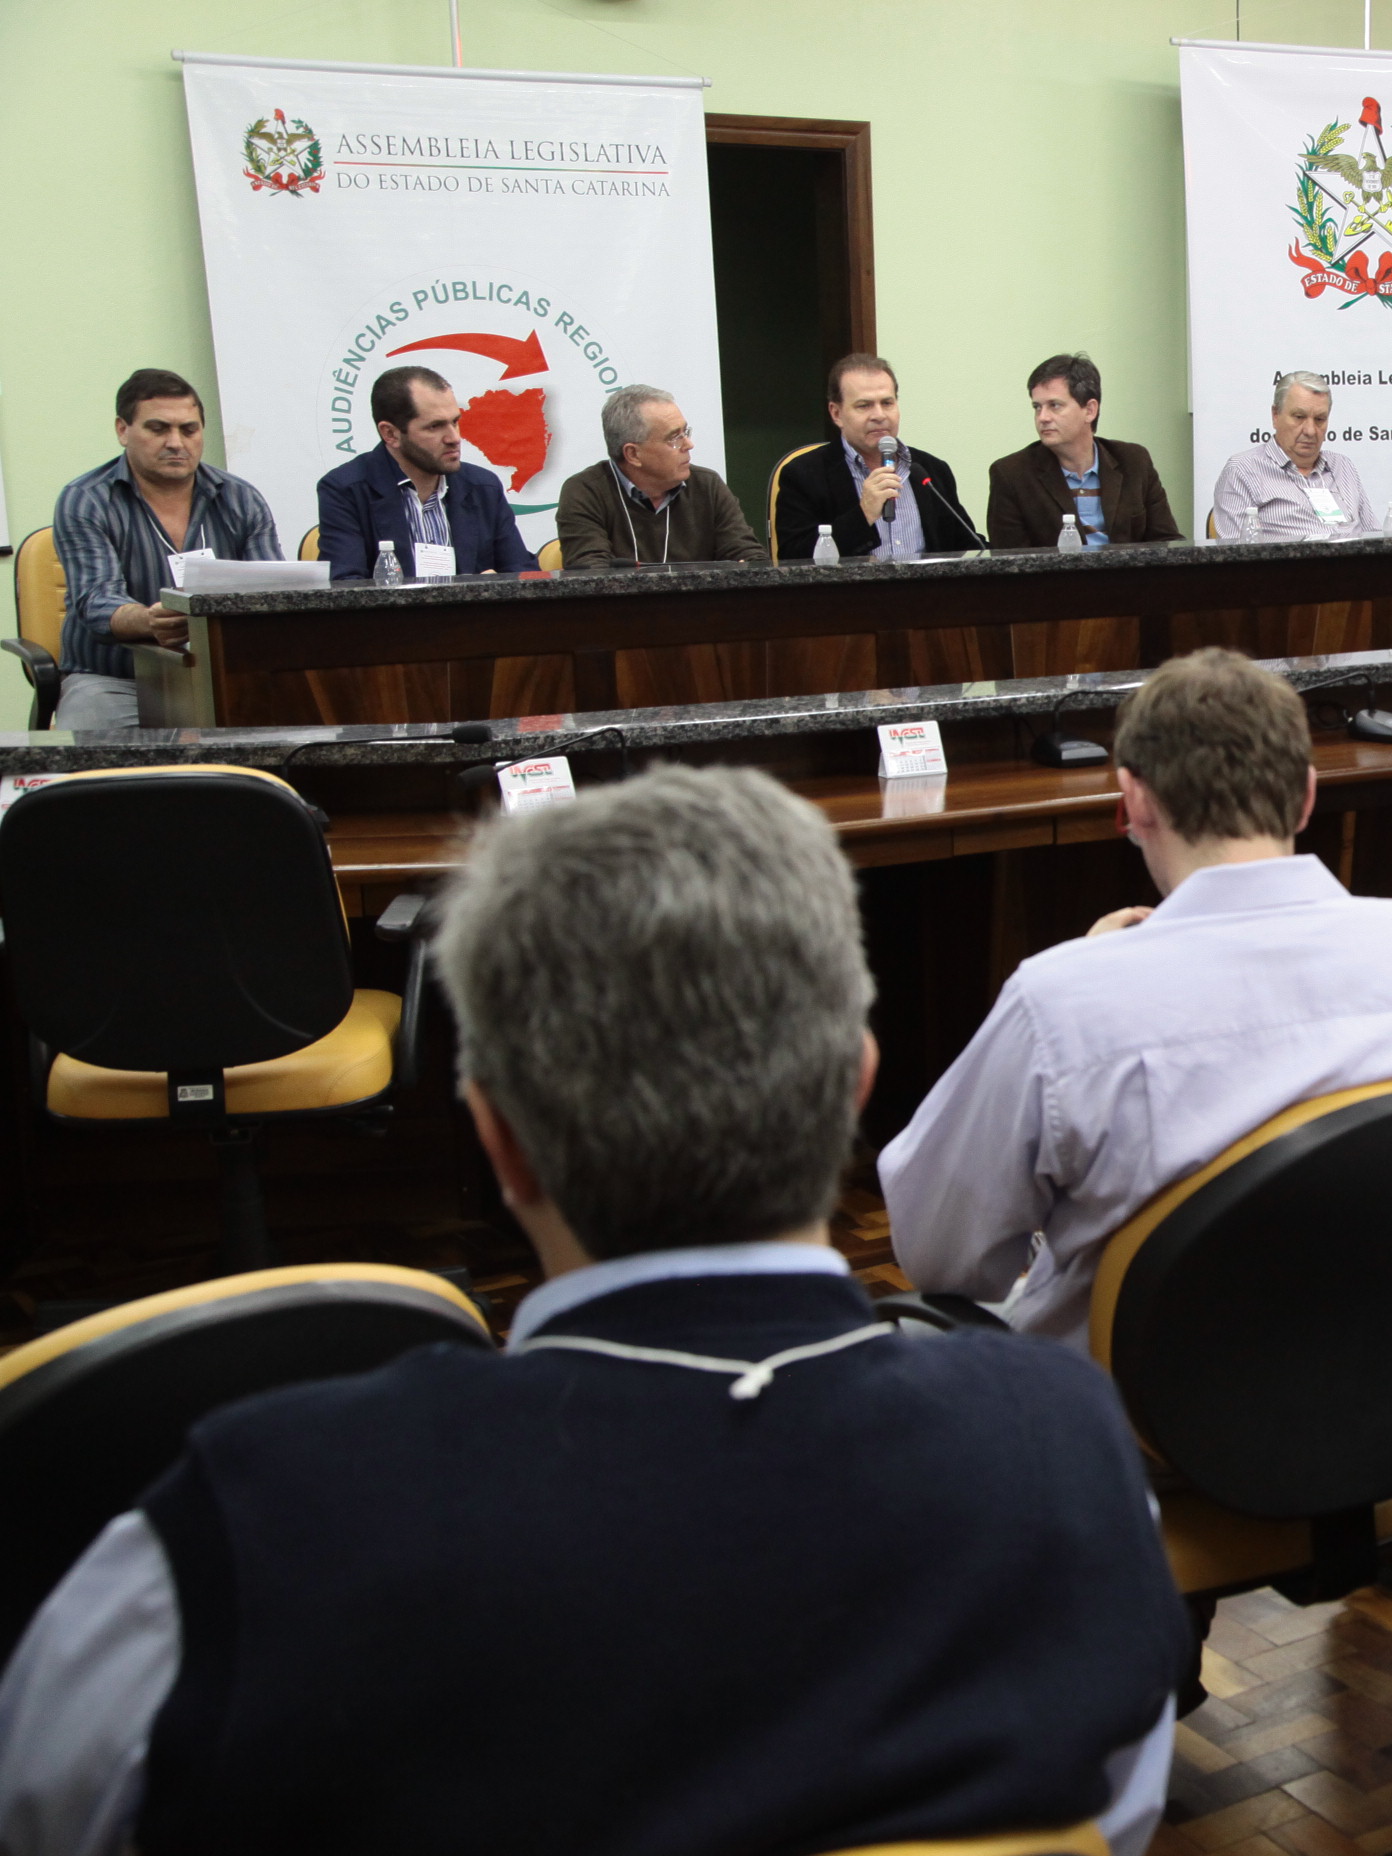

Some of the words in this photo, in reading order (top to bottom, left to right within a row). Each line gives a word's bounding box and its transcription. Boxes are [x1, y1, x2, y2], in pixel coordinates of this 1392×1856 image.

[337, 133, 501, 160] ASSEMBLEIA
[509, 139, 668, 165] LEGISLATIVA
[336, 172, 370, 189] DO
[378, 173, 459, 192] ESTADO
[467, 176, 494, 193] DE
[501, 177, 566, 195] SANTA
[571, 179, 671, 197] CATARINA
[1304, 273, 1345, 288] ESTADO
[331, 300, 410, 455] AUDIÊNCIAS
[412, 279, 552, 319] PÚBLICAS
[554, 310, 624, 395] REGIO
[1342, 427, 1363, 441] de
